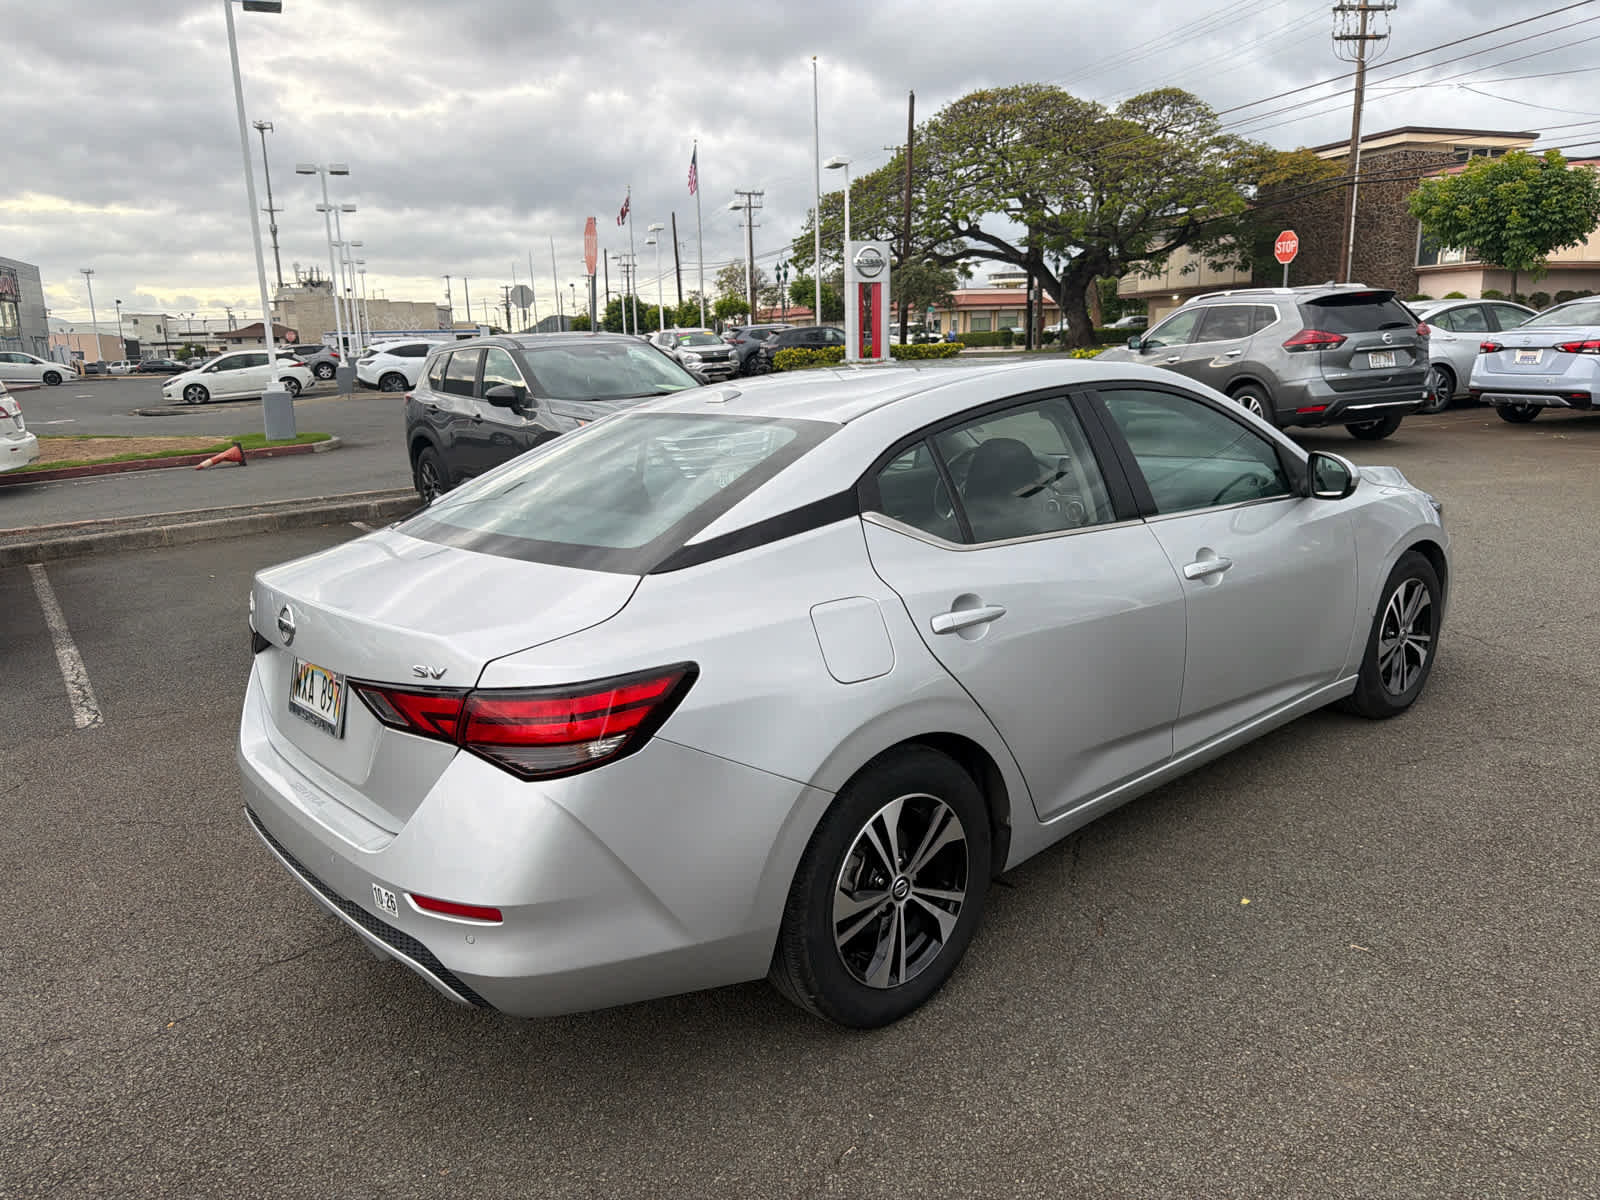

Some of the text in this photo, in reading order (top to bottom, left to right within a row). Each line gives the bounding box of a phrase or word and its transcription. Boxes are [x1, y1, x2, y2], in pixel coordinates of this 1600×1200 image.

[1276, 241, 1297, 254] STOP
[412, 665, 447, 680] SV
[321, 676, 341, 719] 897
